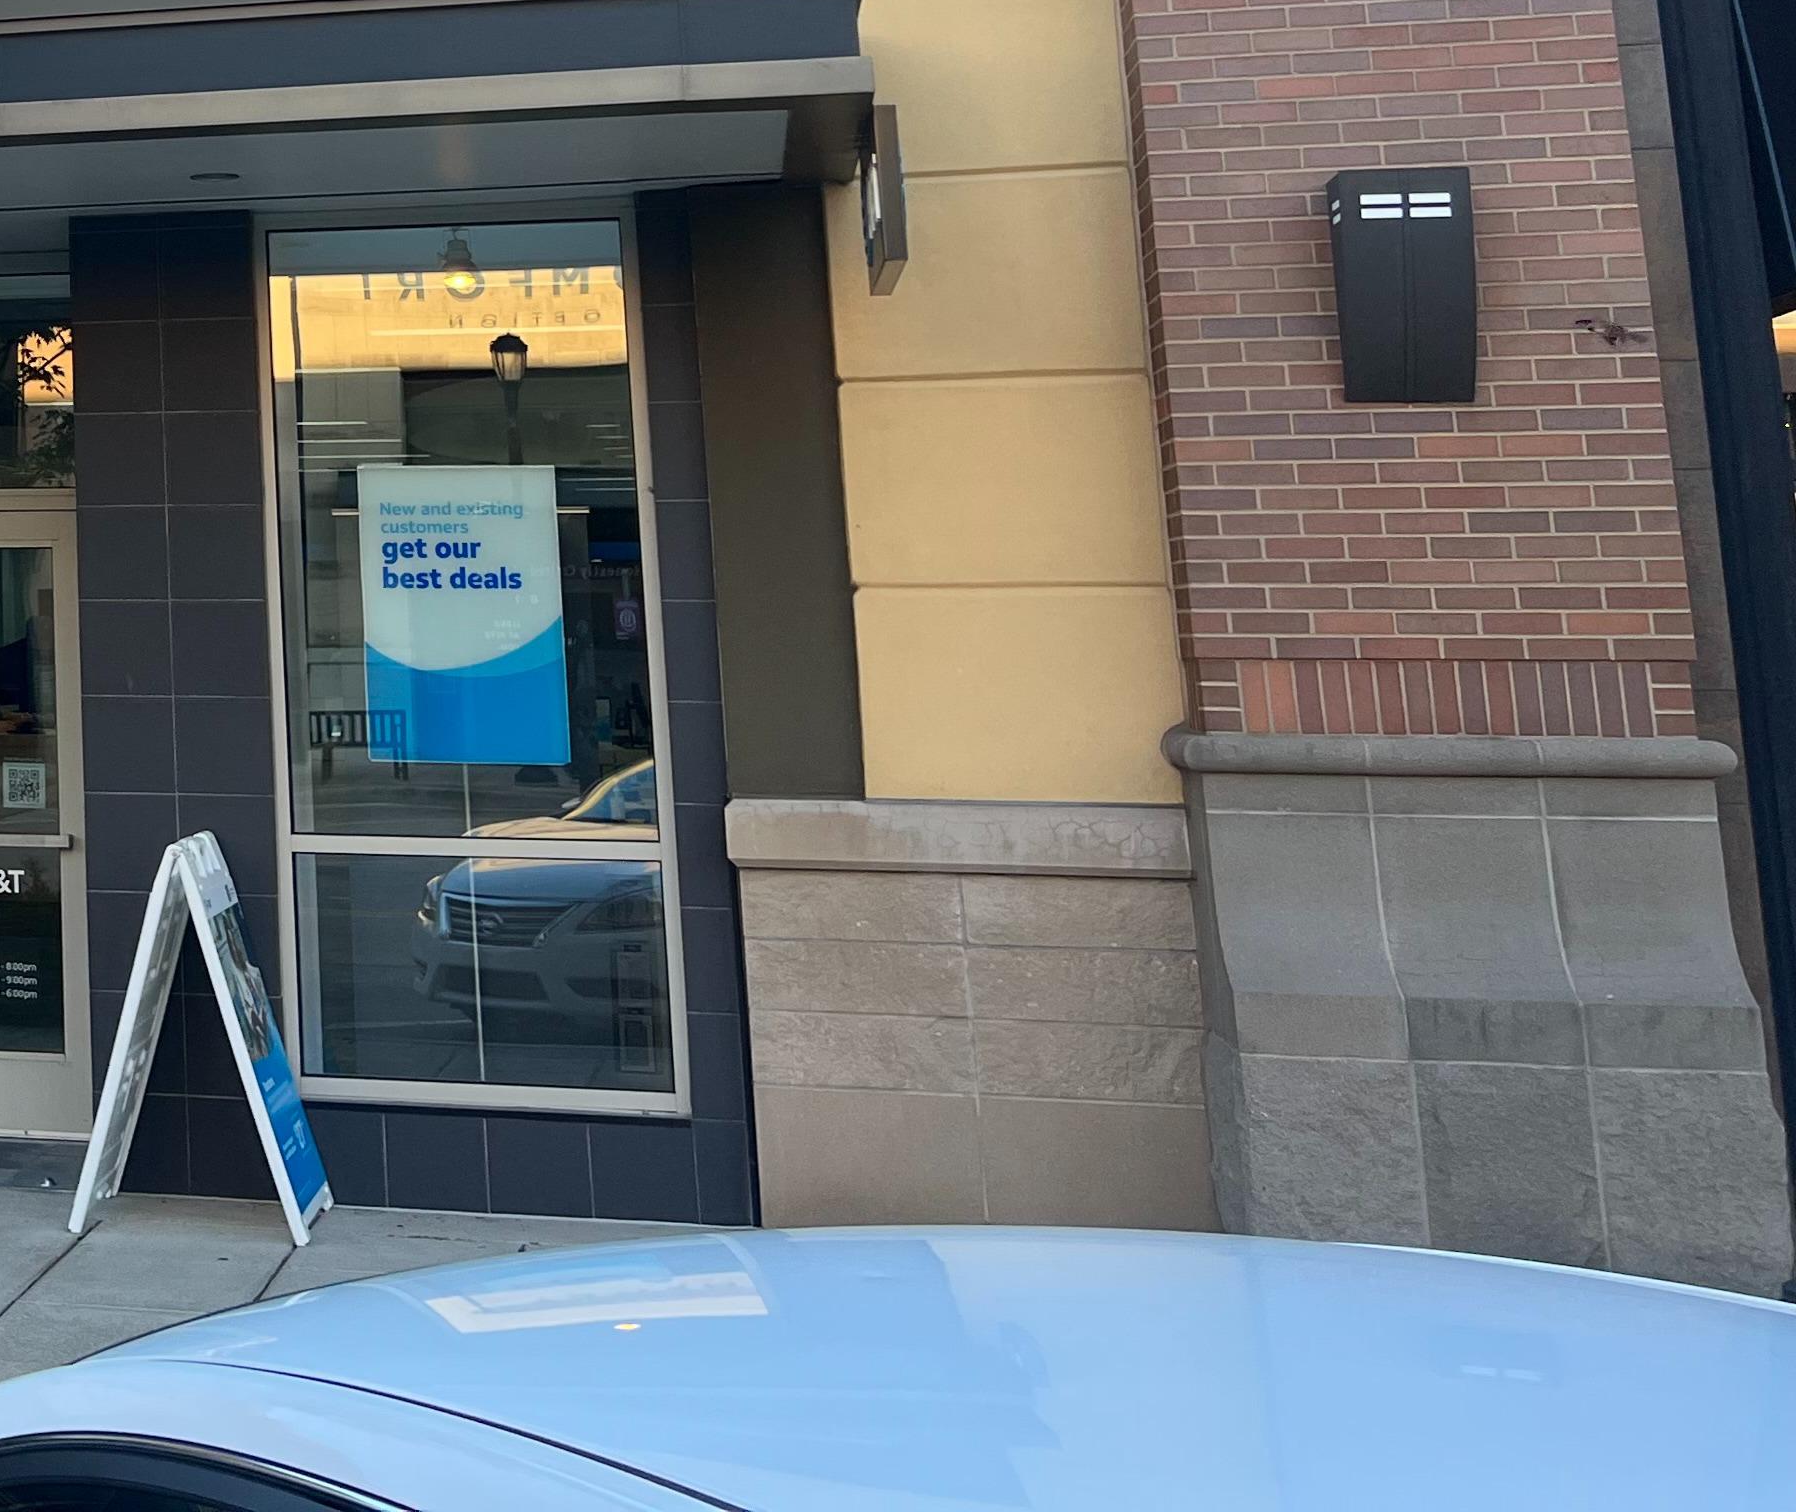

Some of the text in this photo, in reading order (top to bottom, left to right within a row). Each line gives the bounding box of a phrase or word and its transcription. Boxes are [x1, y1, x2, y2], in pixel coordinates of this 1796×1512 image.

[379, 501, 524, 519] New and existing
[380, 520, 469, 535] customers
[381, 539, 482, 565] get our
[381, 567, 443, 590] best
[449, 567, 523, 590] deals
[5, 961, 37, 973] 8:00pm
[5, 975, 38, 987] 9:00pm
[5, 988, 38, 1000] 6:00pm
